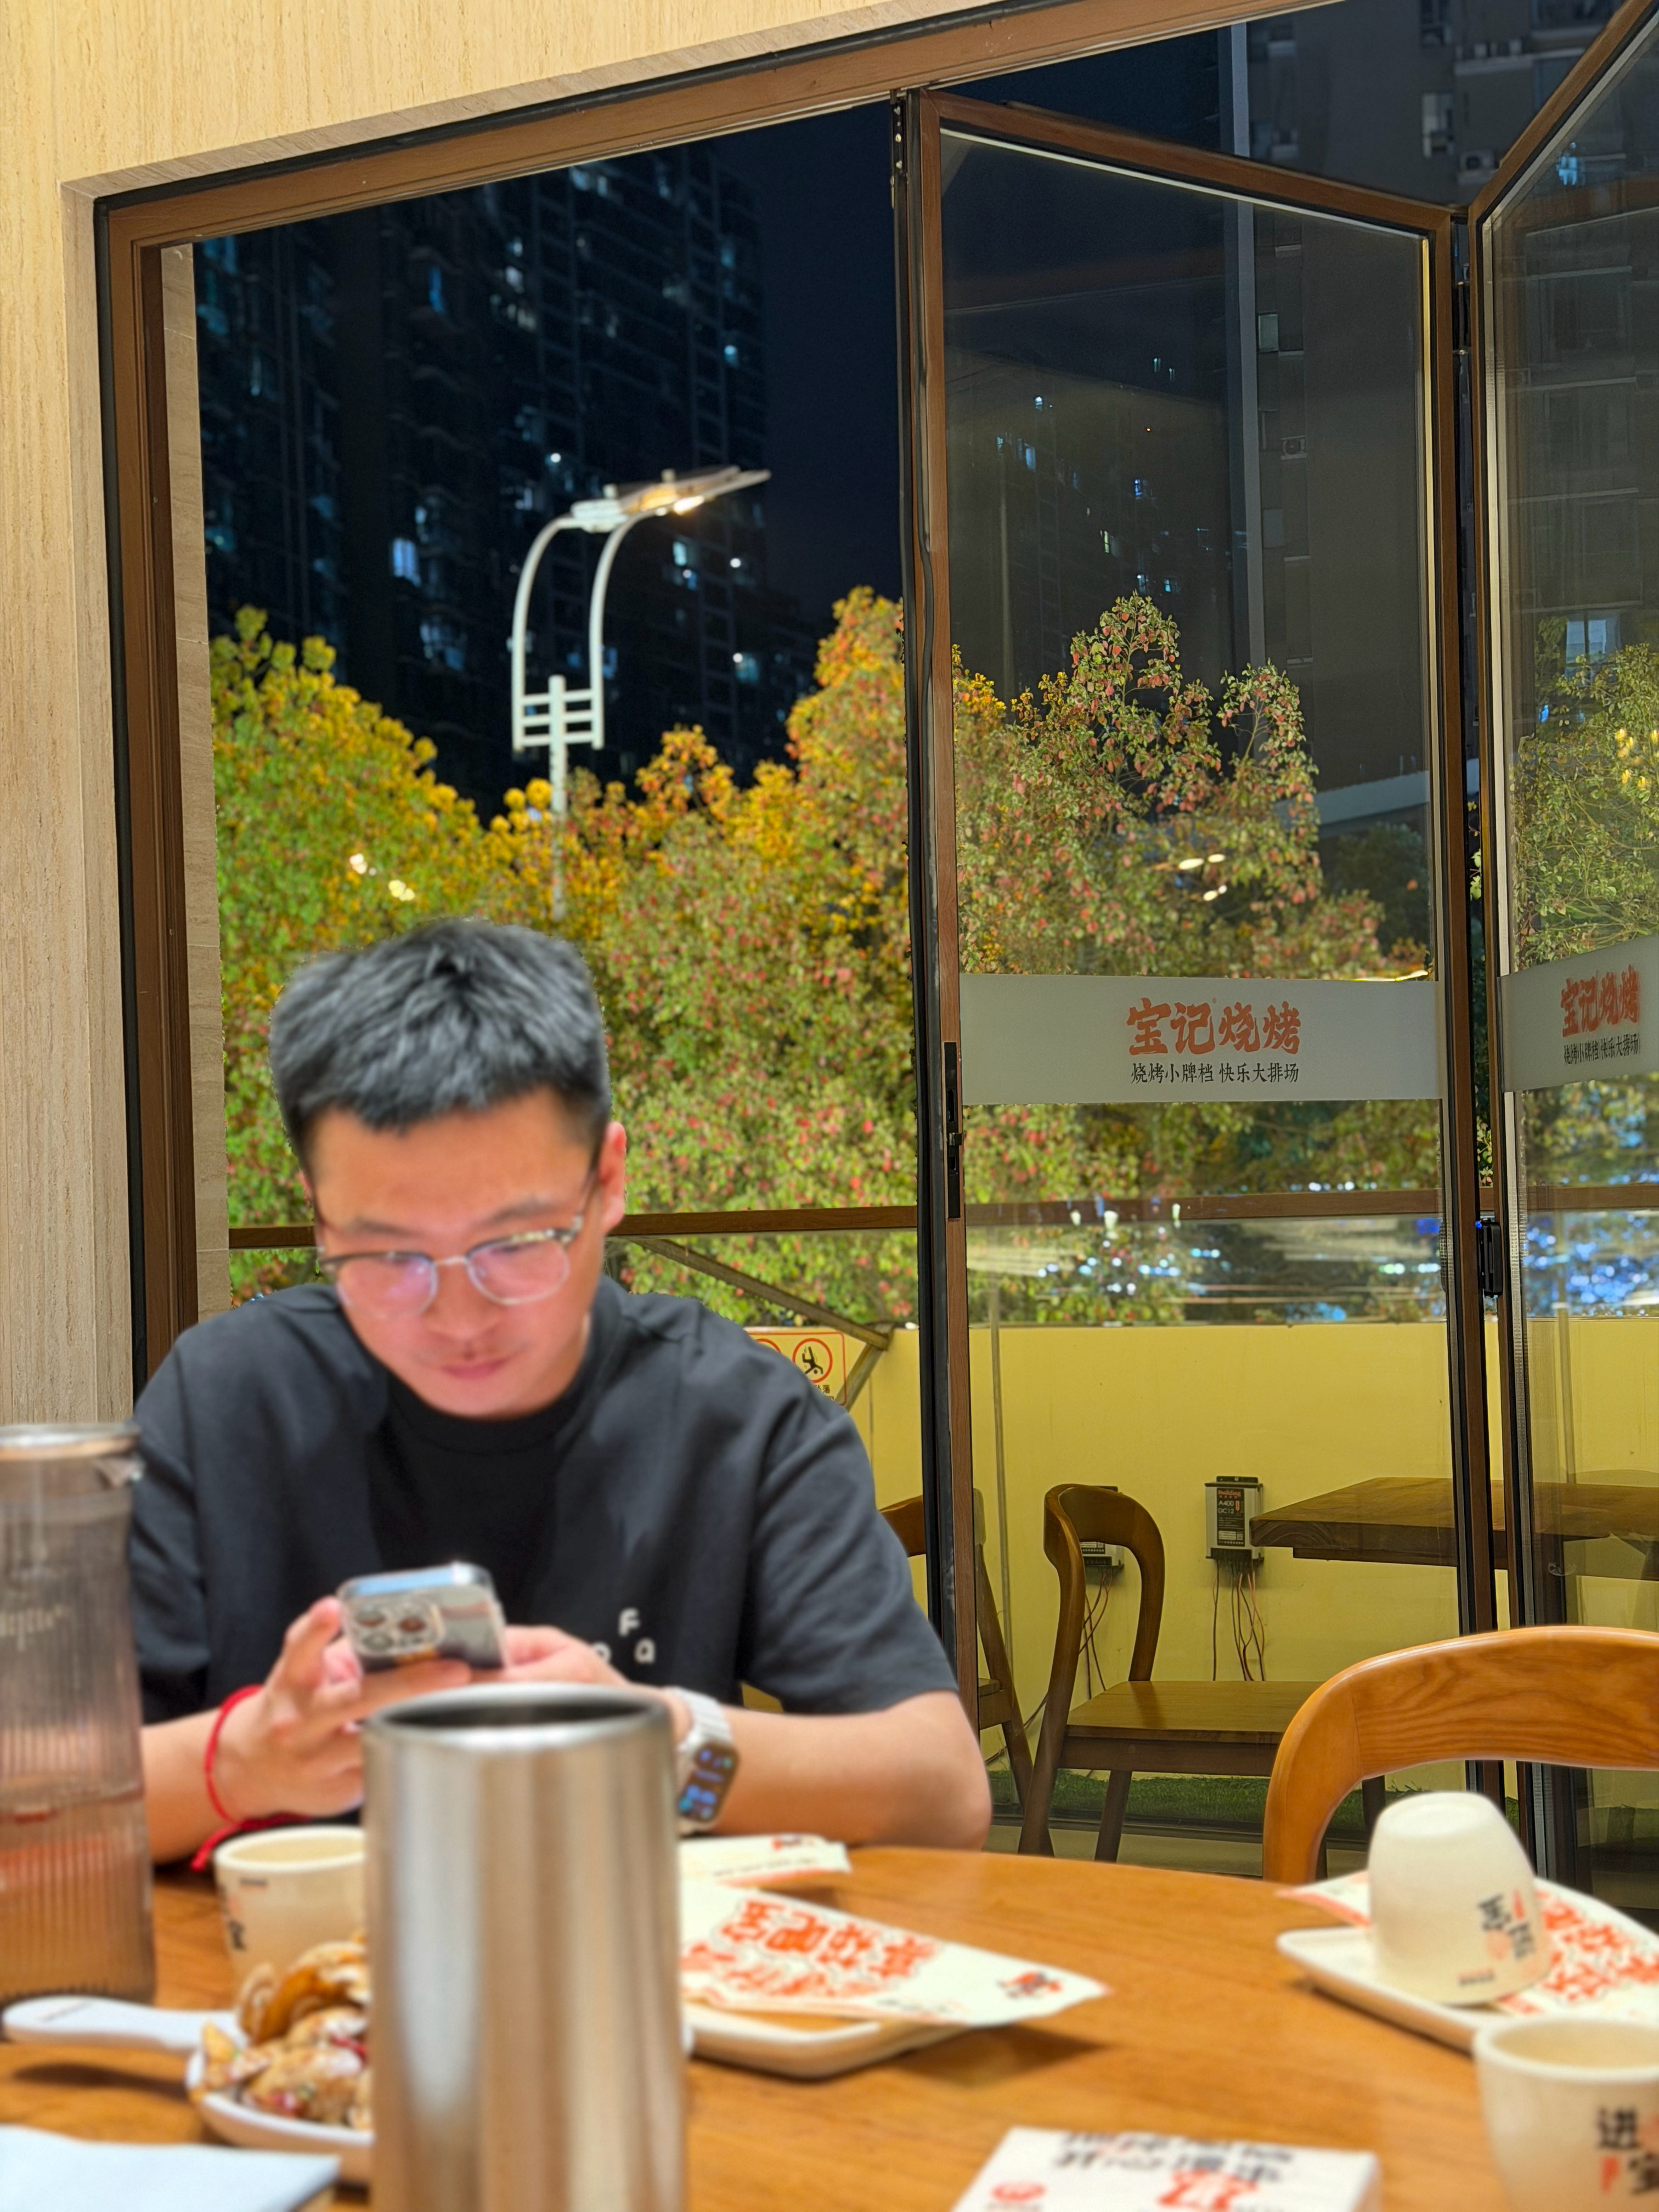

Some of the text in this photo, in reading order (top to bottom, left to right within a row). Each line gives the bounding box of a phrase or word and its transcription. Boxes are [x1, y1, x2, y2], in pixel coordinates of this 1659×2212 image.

[1126, 997, 1301, 1054] 宝记烧烤
[1560, 964, 1639, 1037] 宝记烧烤
[1131, 1062, 1299, 1084] 烧烤小牌档 快乐大排场
